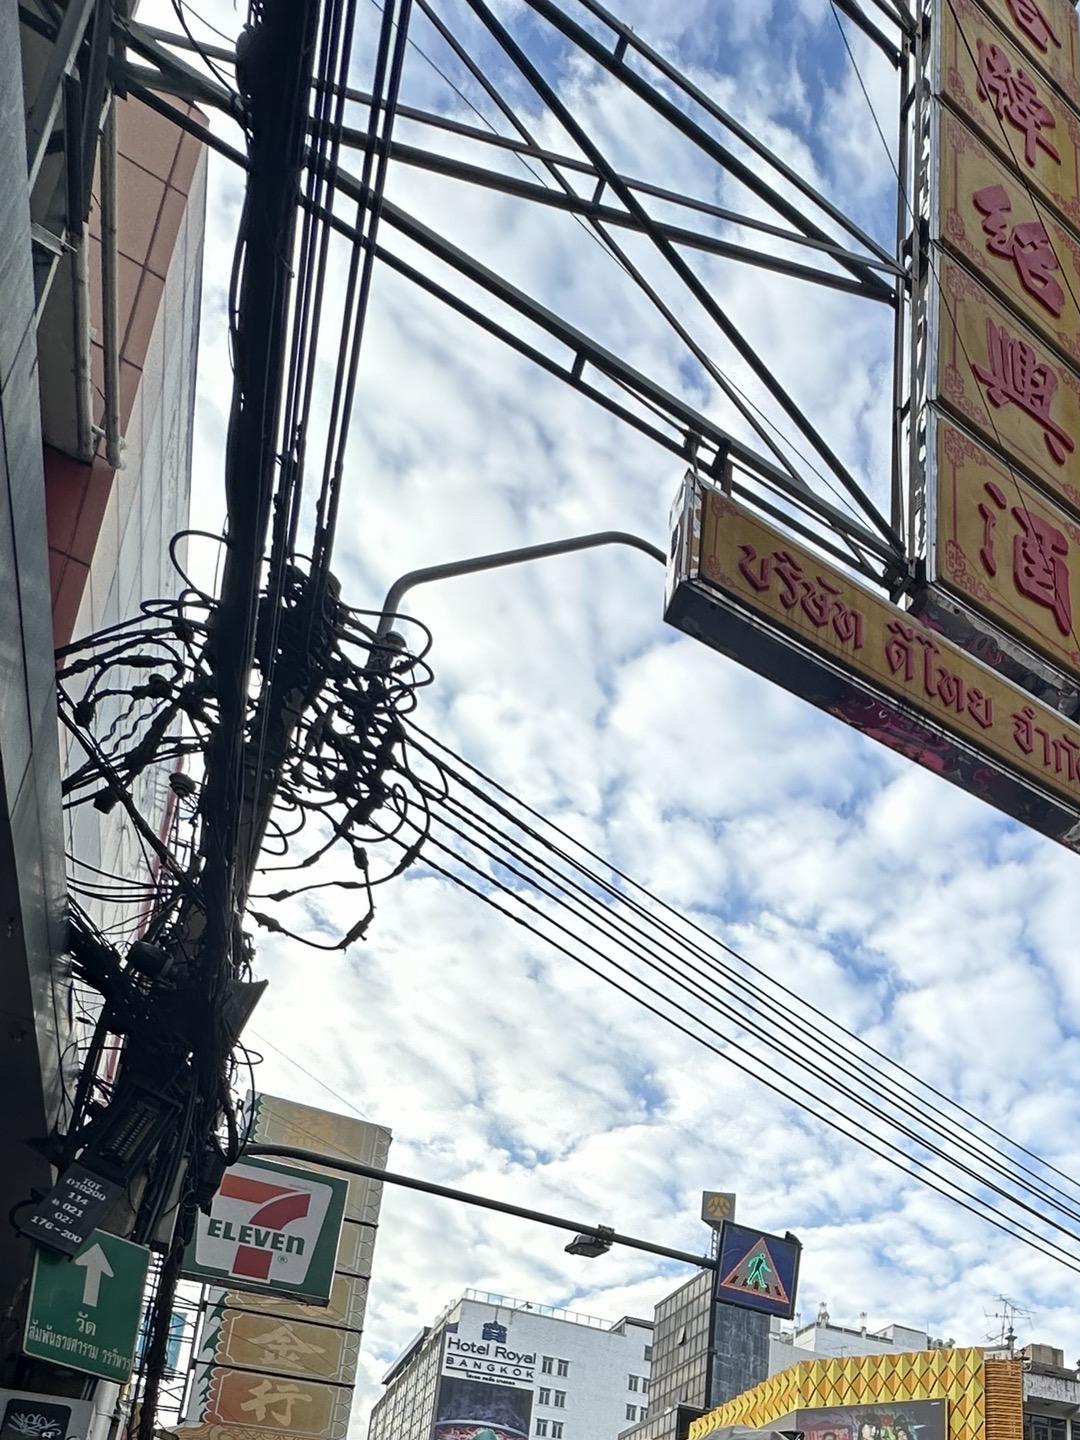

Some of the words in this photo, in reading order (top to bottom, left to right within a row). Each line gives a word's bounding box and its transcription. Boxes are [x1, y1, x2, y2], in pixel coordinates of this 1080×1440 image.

[737, 543, 864, 650] บริษัท
[66, 1178, 106, 1201] 010200
[83, 1178, 103, 1190] TOT
[68, 1191, 89, 1205] 114
[31, 1216, 82, 1243] 176-200
[76, 1311, 97, 1336] วัด
[447, 1336, 490, 1356] Hotel
[494, 1345, 537, 1365] Royal
[446, 1356, 534, 1379] BANGKOK
